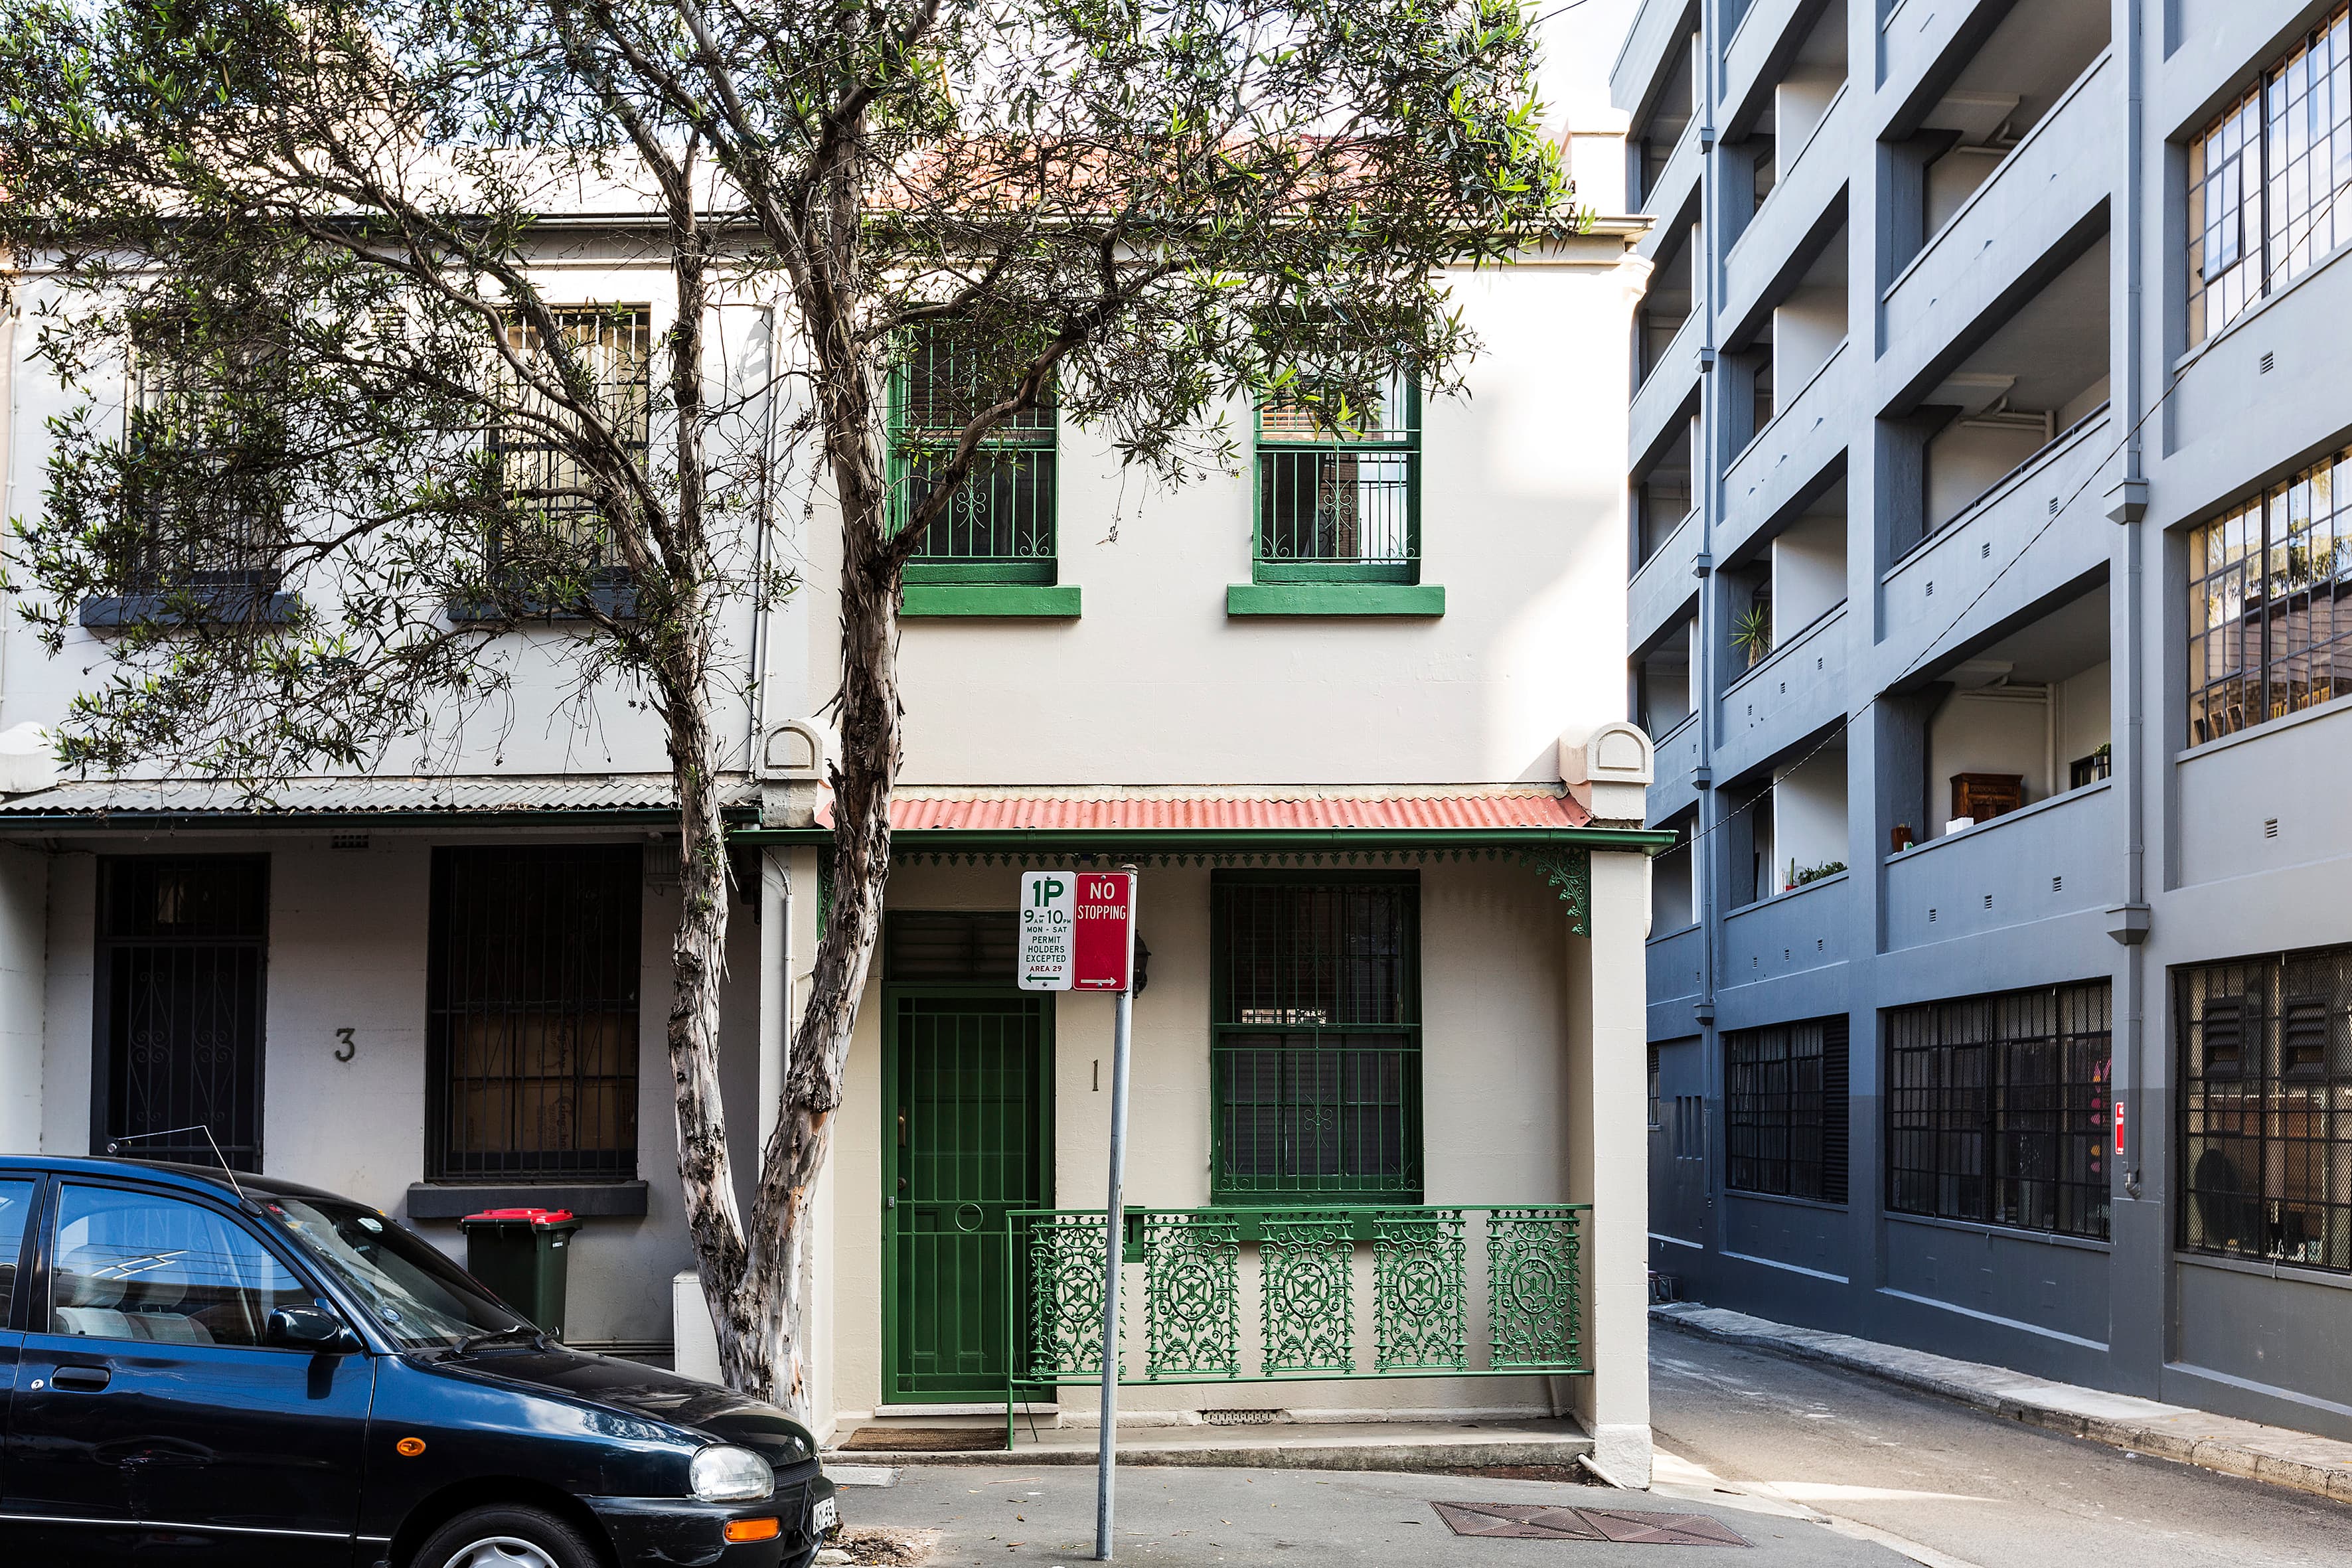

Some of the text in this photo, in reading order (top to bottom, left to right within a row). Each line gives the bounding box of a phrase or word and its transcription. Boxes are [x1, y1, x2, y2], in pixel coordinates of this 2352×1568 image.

[1032, 880, 1064, 907] 1P
[1090, 882, 1115, 900] NO
[1077, 905, 1127, 920] STOPPING
[335, 1028, 355, 1062] 3
[1092, 1059, 1099, 1091] 1
